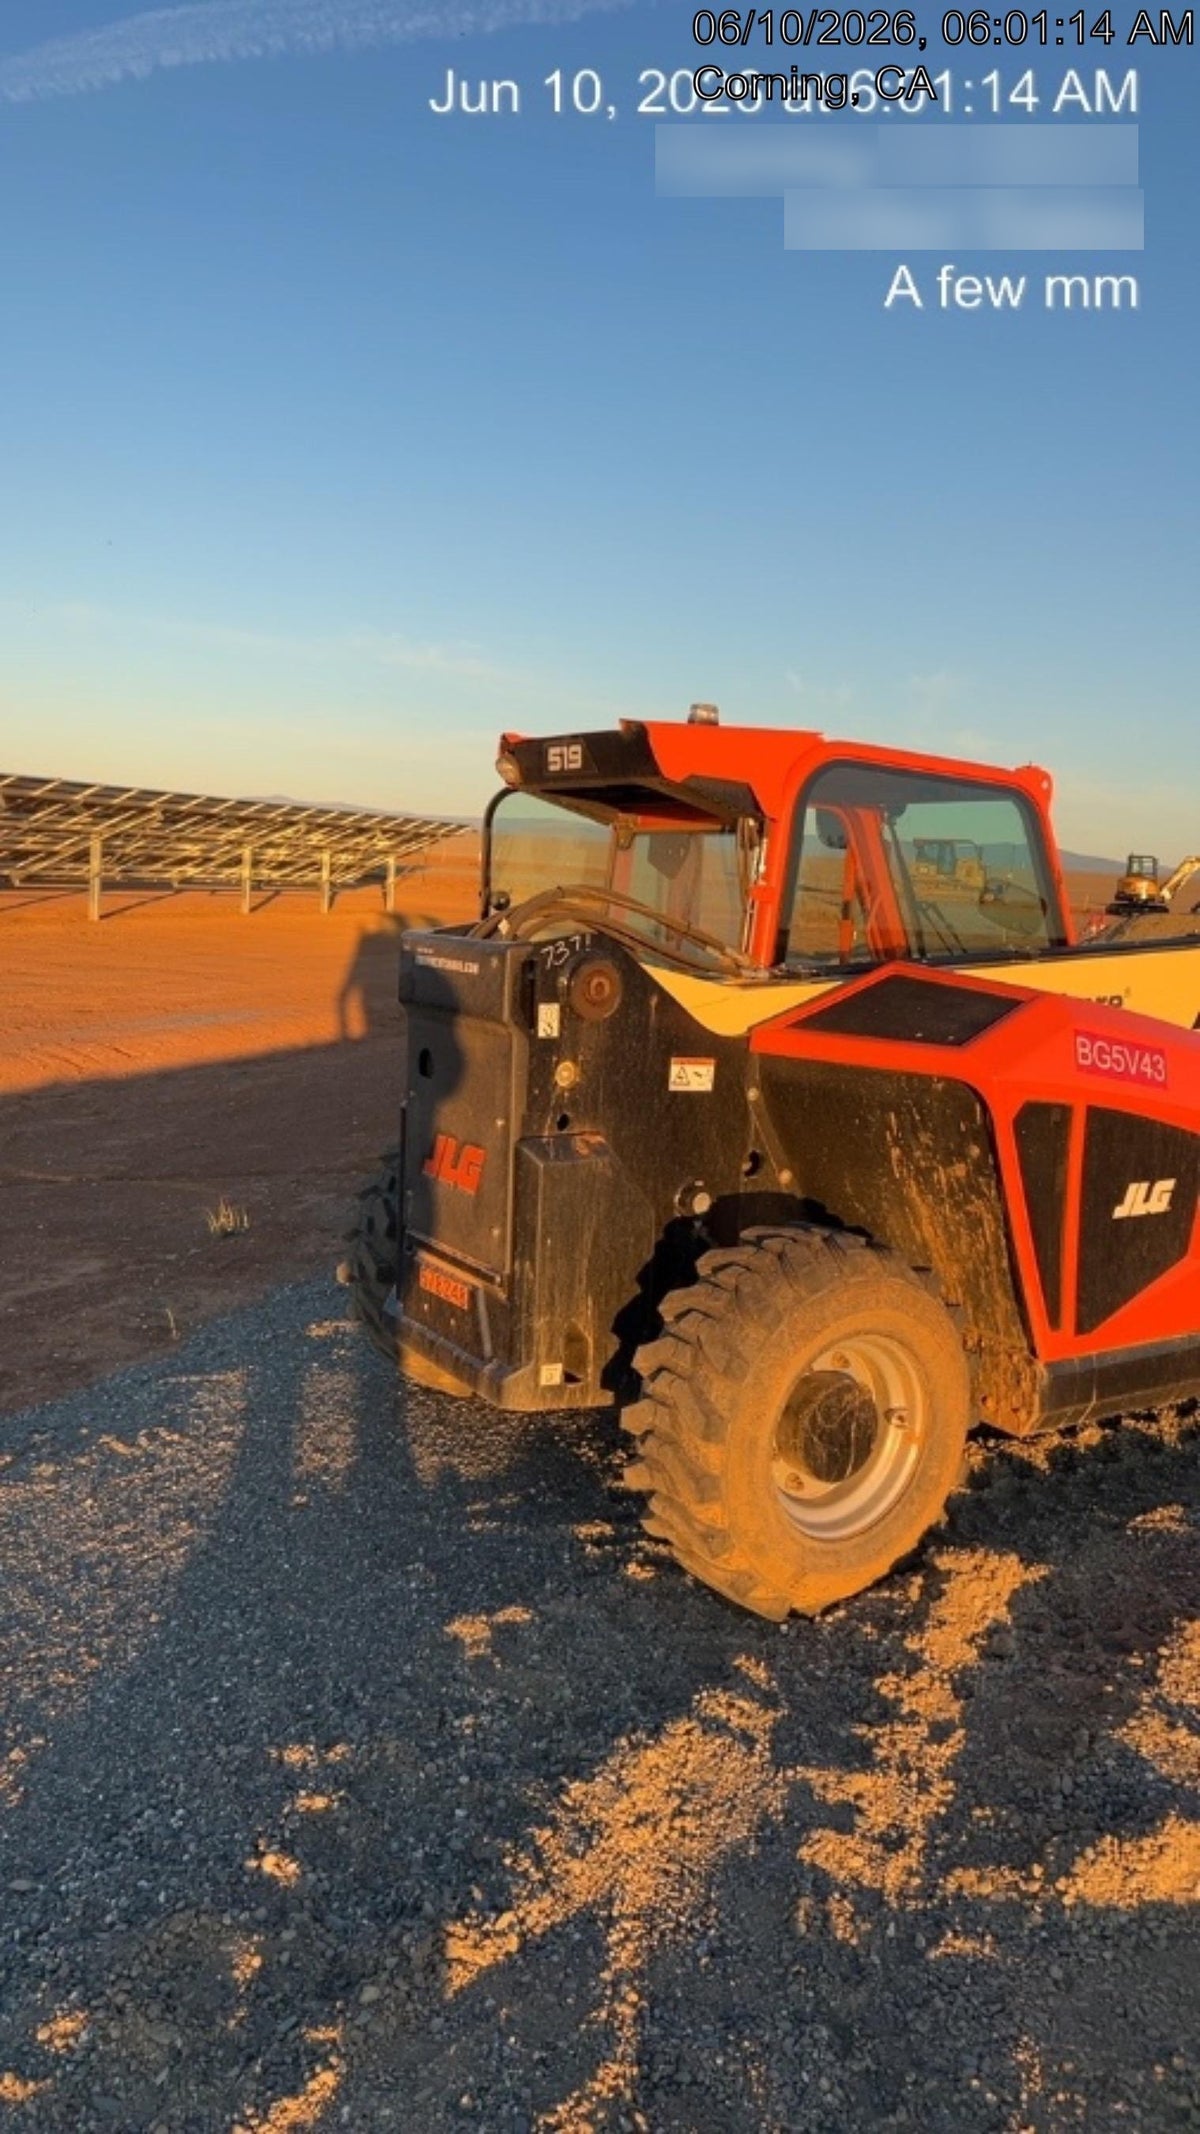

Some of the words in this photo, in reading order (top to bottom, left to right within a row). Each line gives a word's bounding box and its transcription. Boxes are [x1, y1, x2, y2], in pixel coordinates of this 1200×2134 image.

[547, 744, 582, 772] 519
[1076, 1035, 1166, 1082] BG5V43
[424, 1134, 485, 1195] JLG
[1112, 1178, 1176, 1219] JLG
